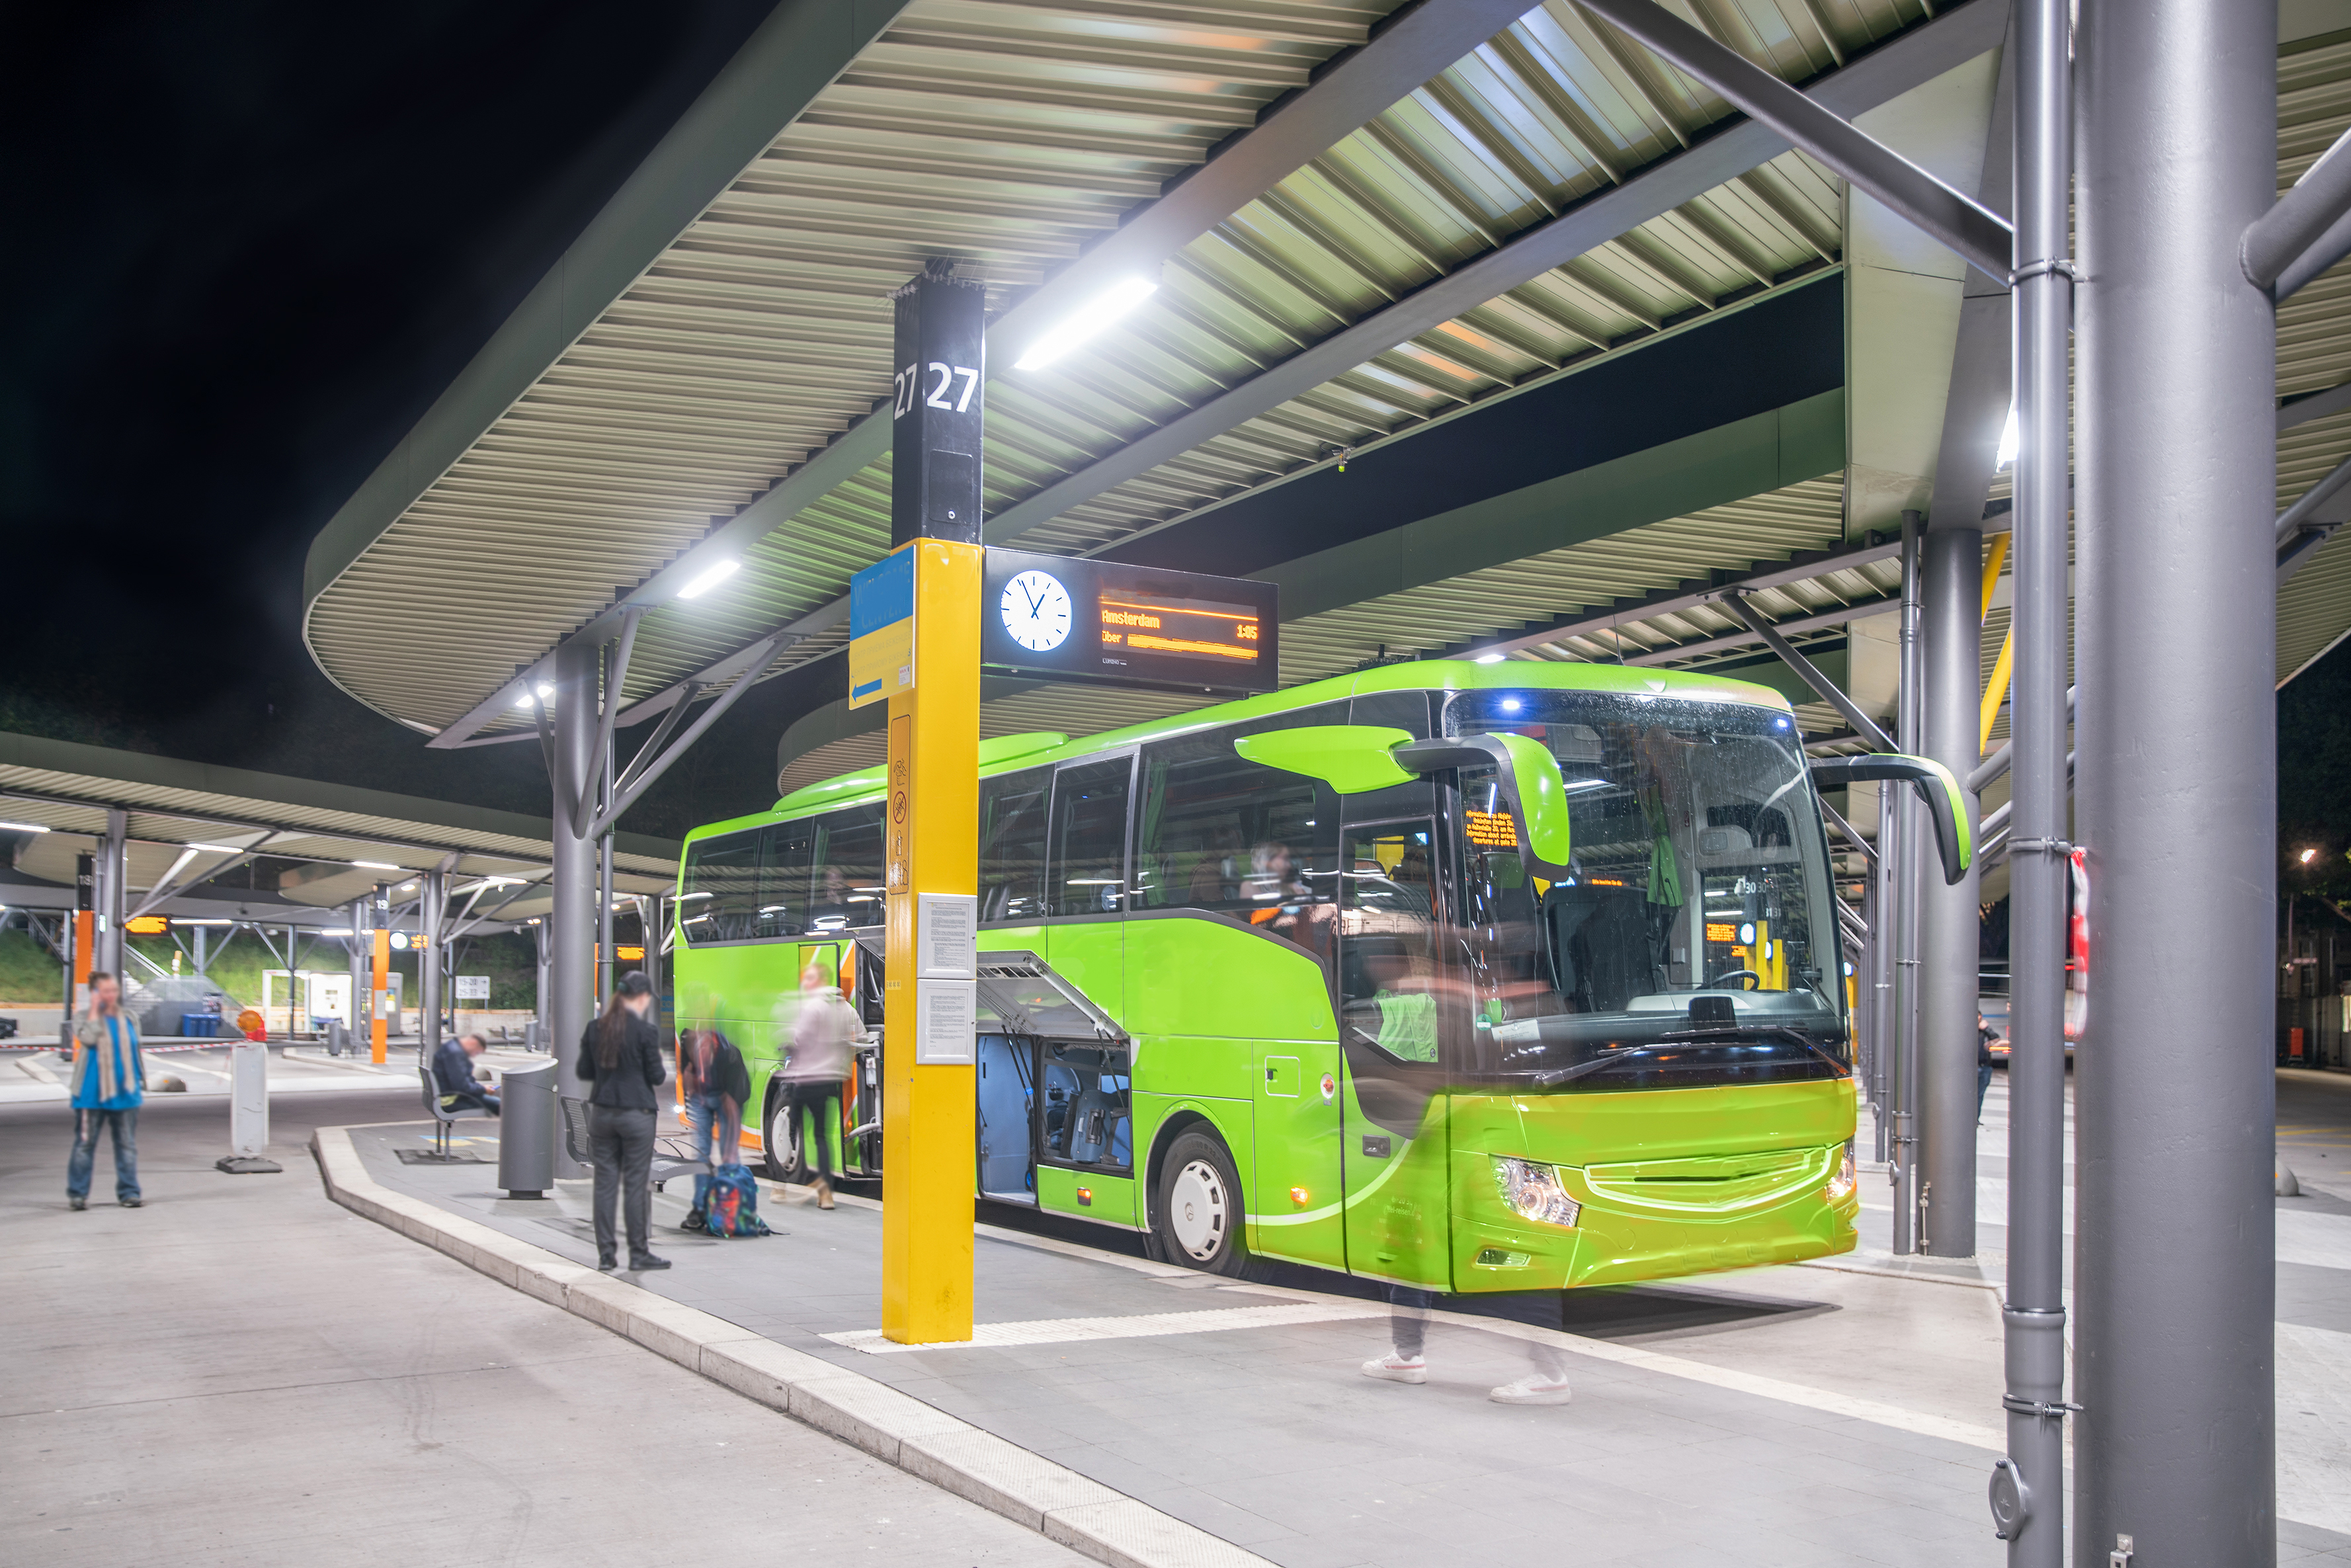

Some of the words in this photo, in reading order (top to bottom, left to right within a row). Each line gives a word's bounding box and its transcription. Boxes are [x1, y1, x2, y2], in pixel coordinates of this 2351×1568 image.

[894, 362, 917, 421] 27
[927, 362, 979, 413] 27
[1102, 609, 1160, 629] Amsterdam
[1237, 624, 1258, 640] 1:05
[1745, 882, 1756, 894] 30
[376, 899, 389, 910] 19
